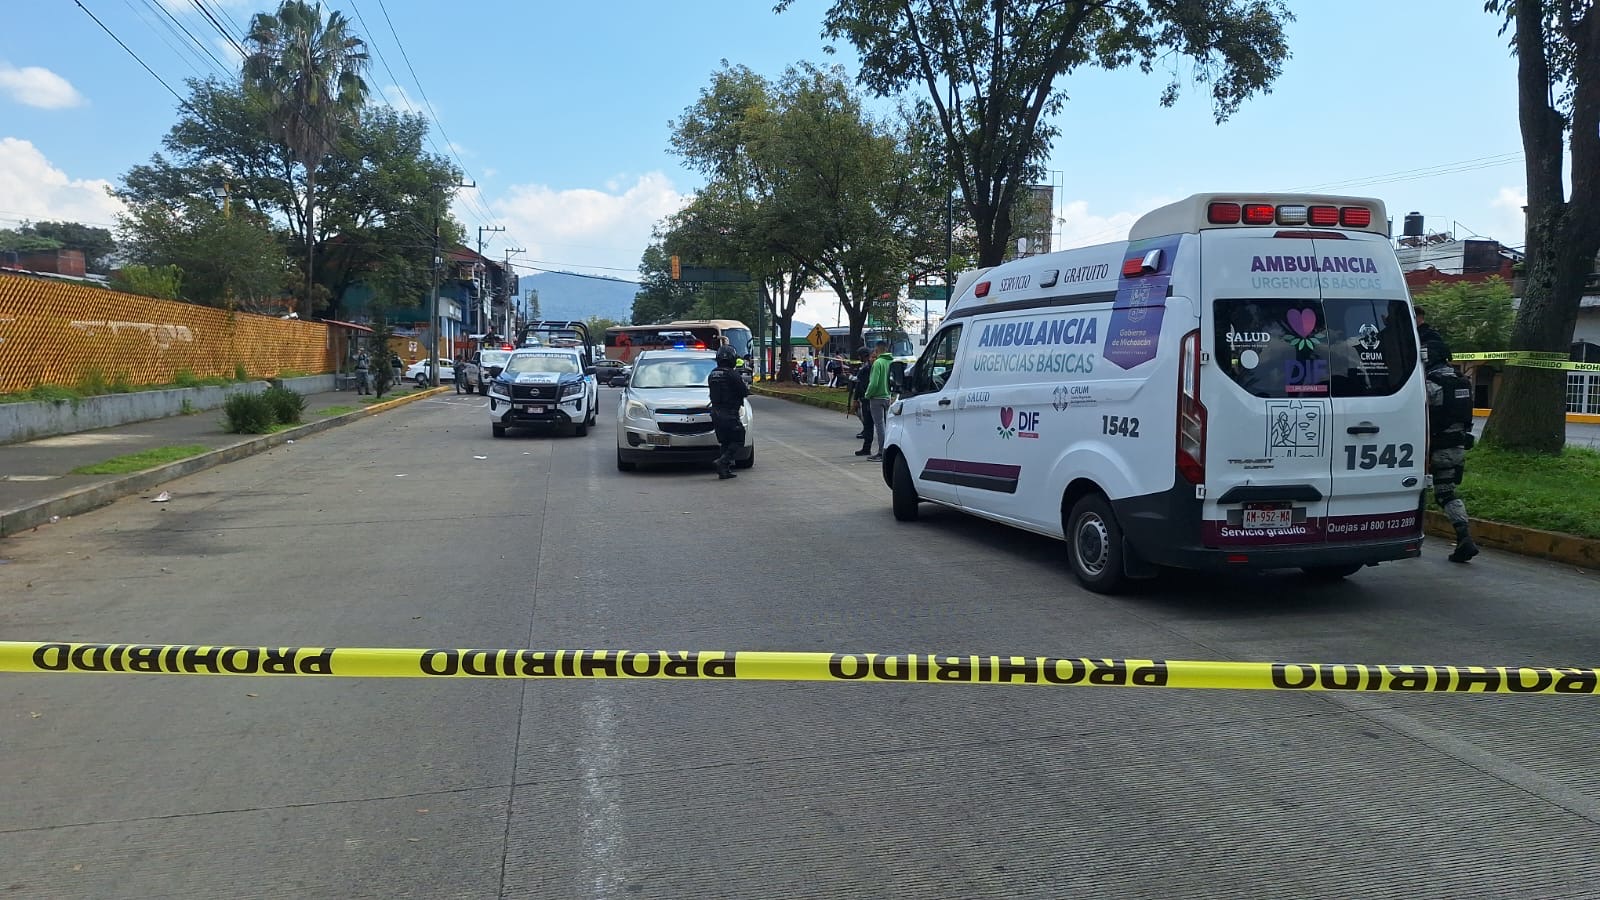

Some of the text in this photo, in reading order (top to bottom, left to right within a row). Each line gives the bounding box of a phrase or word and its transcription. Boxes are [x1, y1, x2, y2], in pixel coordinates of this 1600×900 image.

[1251, 255, 1378, 274] AMBULANCIA
[1000, 263, 1108, 292] SERVICIO GRATUITO
[1252, 275, 1381, 290] URGENCIAS BÁSICAS
[978, 317, 1097, 347] AMBULANCIA
[1226, 332, 1271, 342] SALUD
[974, 350, 1094, 373] URGENCIAS BÁSICAS
[1361, 352, 1382, 360] CRUM
[1284, 359, 1328, 384] DIF
[967, 391, 990, 402] SALUD
[1070, 385, 1089, 394] CRUM
[1018, 411, 1040, 431] DIF
[1102, 415, 1140, 438] 1542
[1344, 443, 1414, 470] 1542
[1221, 525, 1306, 537] Servicio gratuito
[1328, 523, 1358, 533] Quejas
[1360, 521, 1368, 531] al
[1370, 519, 1384, 530] 800
[1387, 518, 1399, 529] 123
[33, 643, 336, 675] PROHIBIDO
[420, 649, 737, 678] PROHIBIDO
[828, 652, 1169, 687] PROHIBIDO
[1271, 663, 1598, 694] ROHIBIDO
